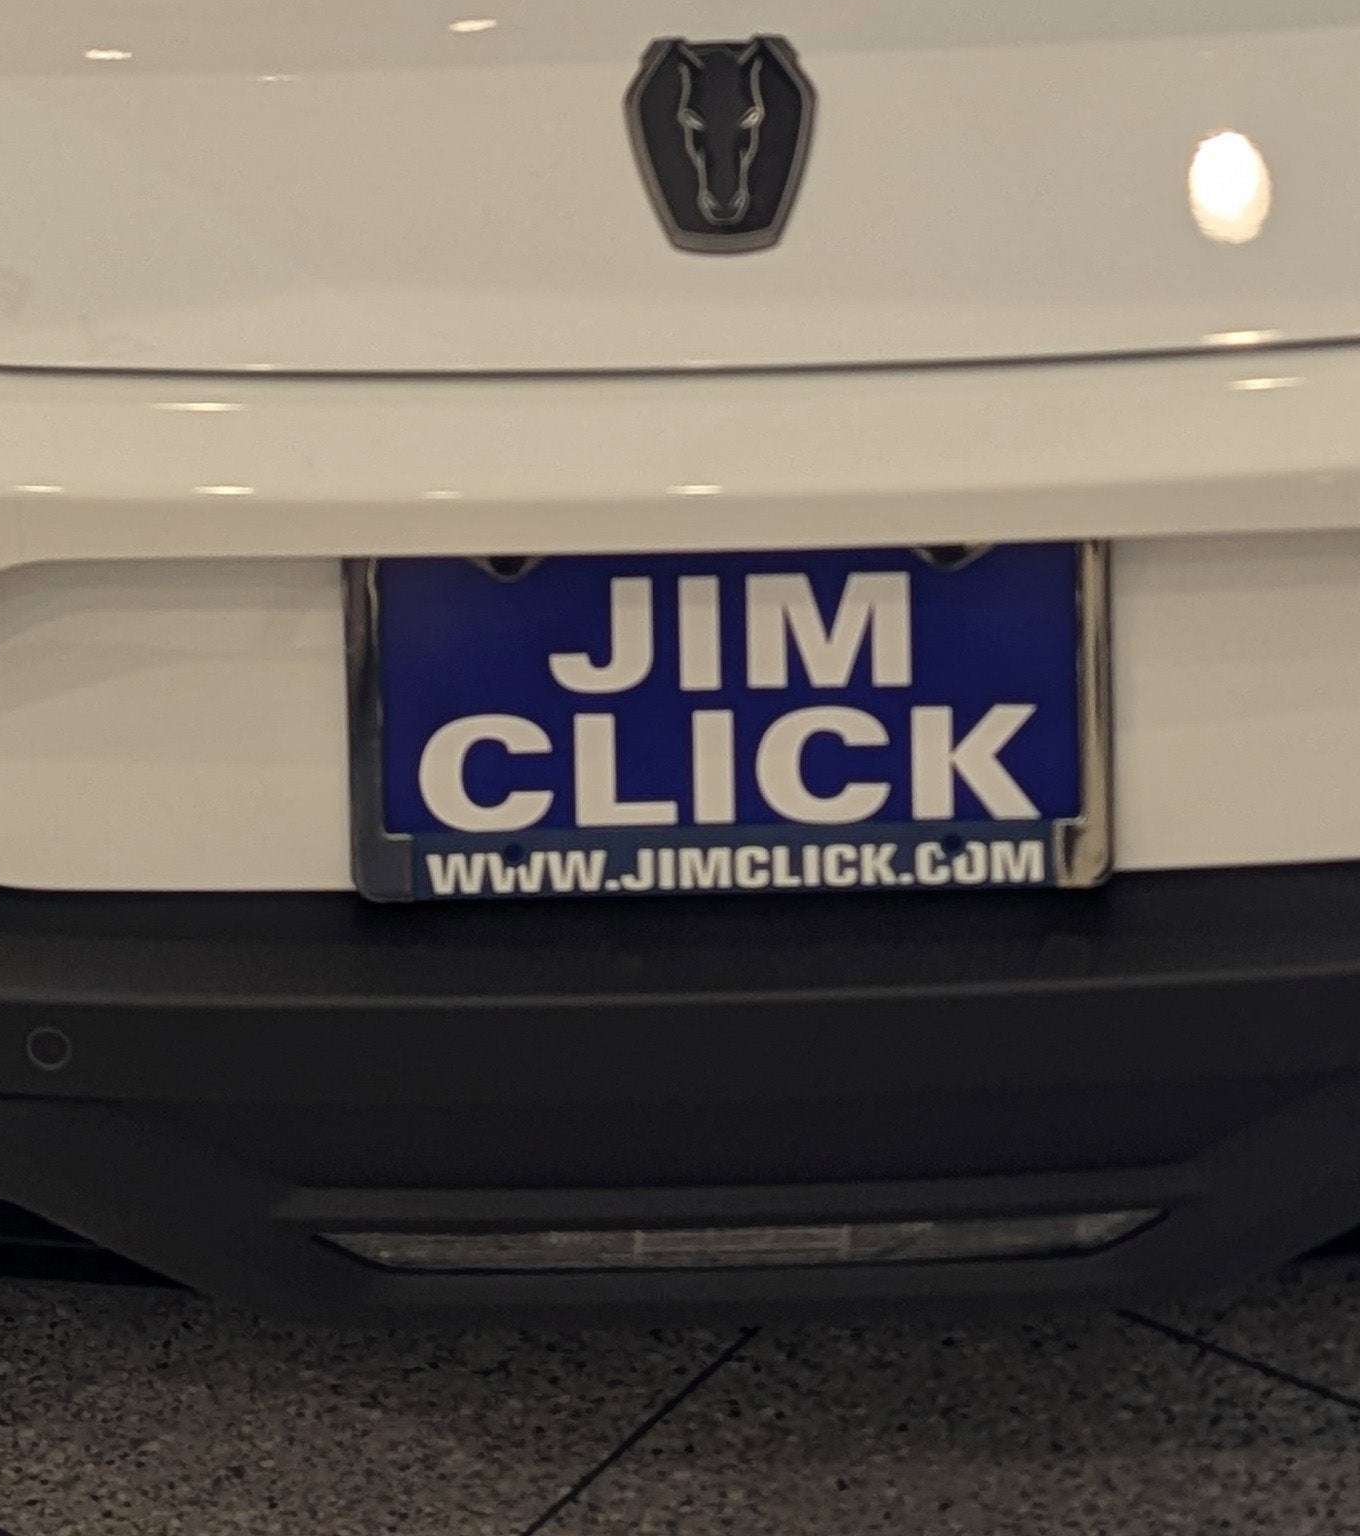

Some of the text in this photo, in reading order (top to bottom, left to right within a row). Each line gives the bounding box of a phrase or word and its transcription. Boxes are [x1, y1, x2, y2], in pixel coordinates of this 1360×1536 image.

[548, 570, 913, 695] JIM
[418, 703, 1041, 833] CLICK
[425, 840, 1046, 896] WWW.JIMCLICK.COM
